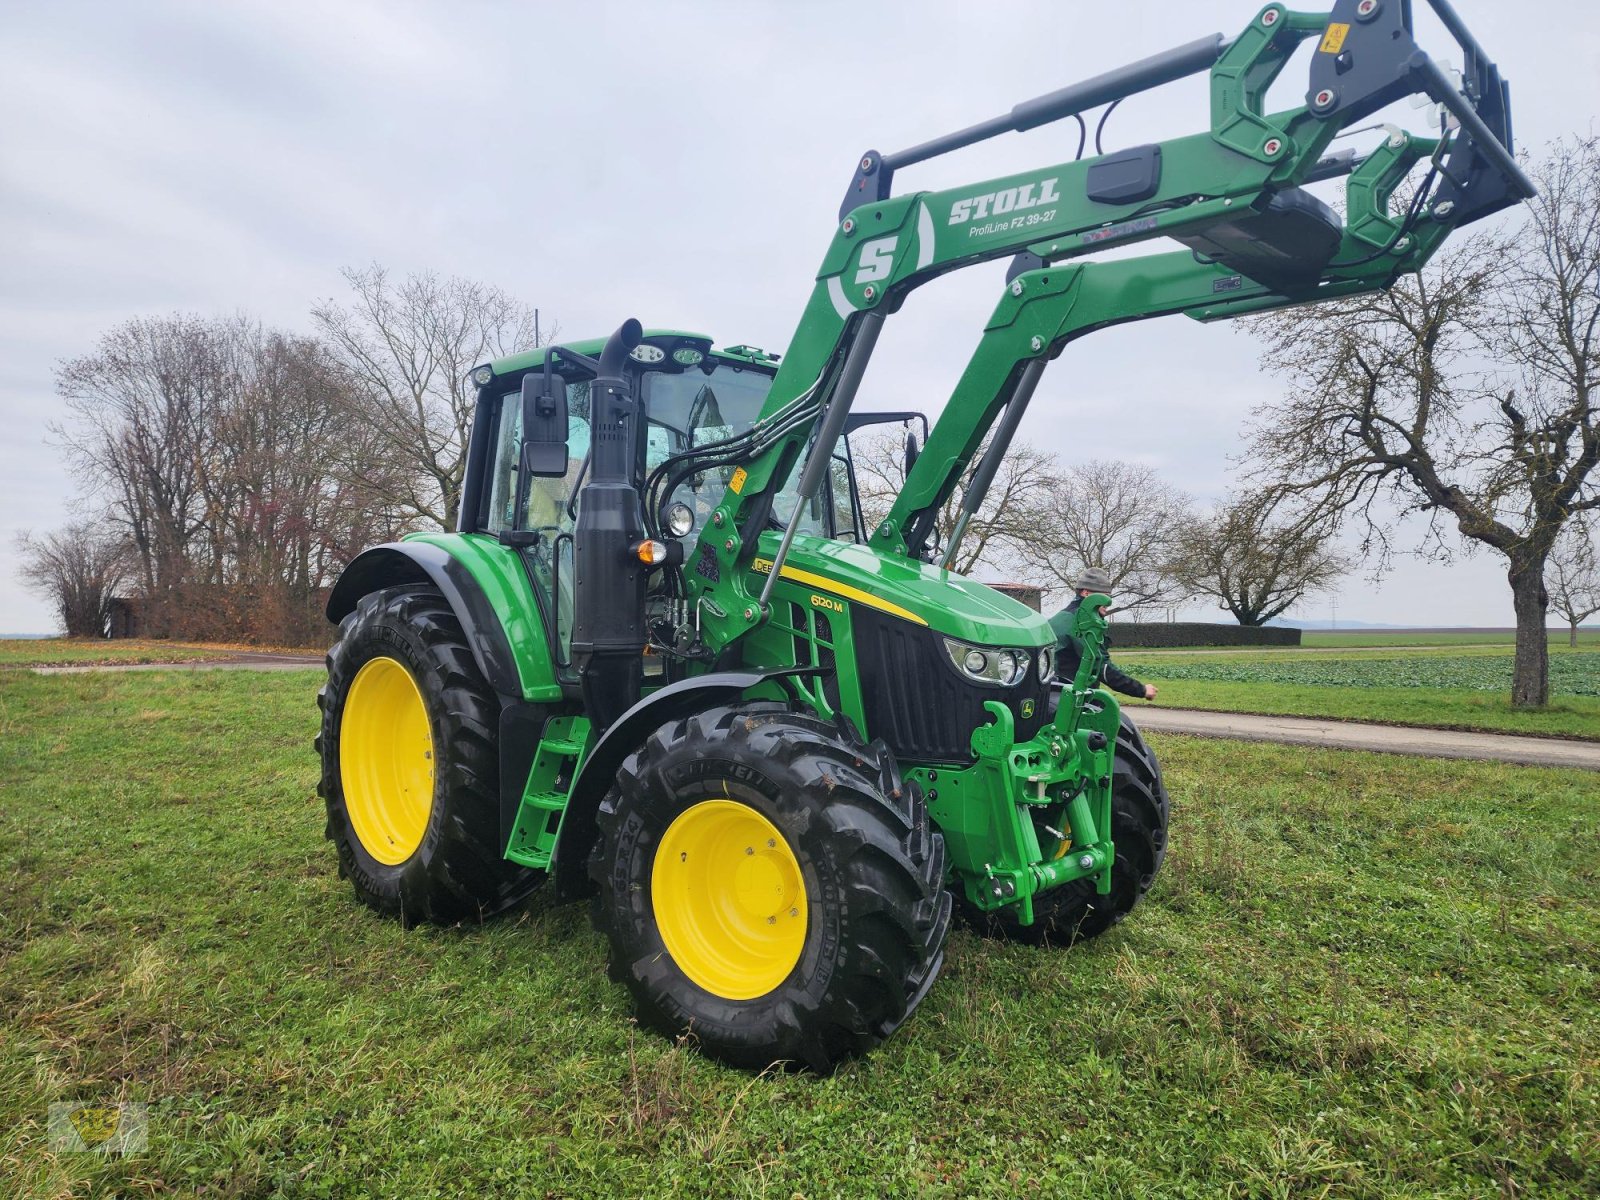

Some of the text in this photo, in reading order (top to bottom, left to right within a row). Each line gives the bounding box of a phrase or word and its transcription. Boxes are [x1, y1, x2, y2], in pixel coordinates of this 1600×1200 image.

[948, 178, 1060, 225] STOLL
[969, 210, 1056, 238] ProfiLine FZ 39-27
[854, 235, 899, 285] S
[810, 594, 843, 613] 6120 M
